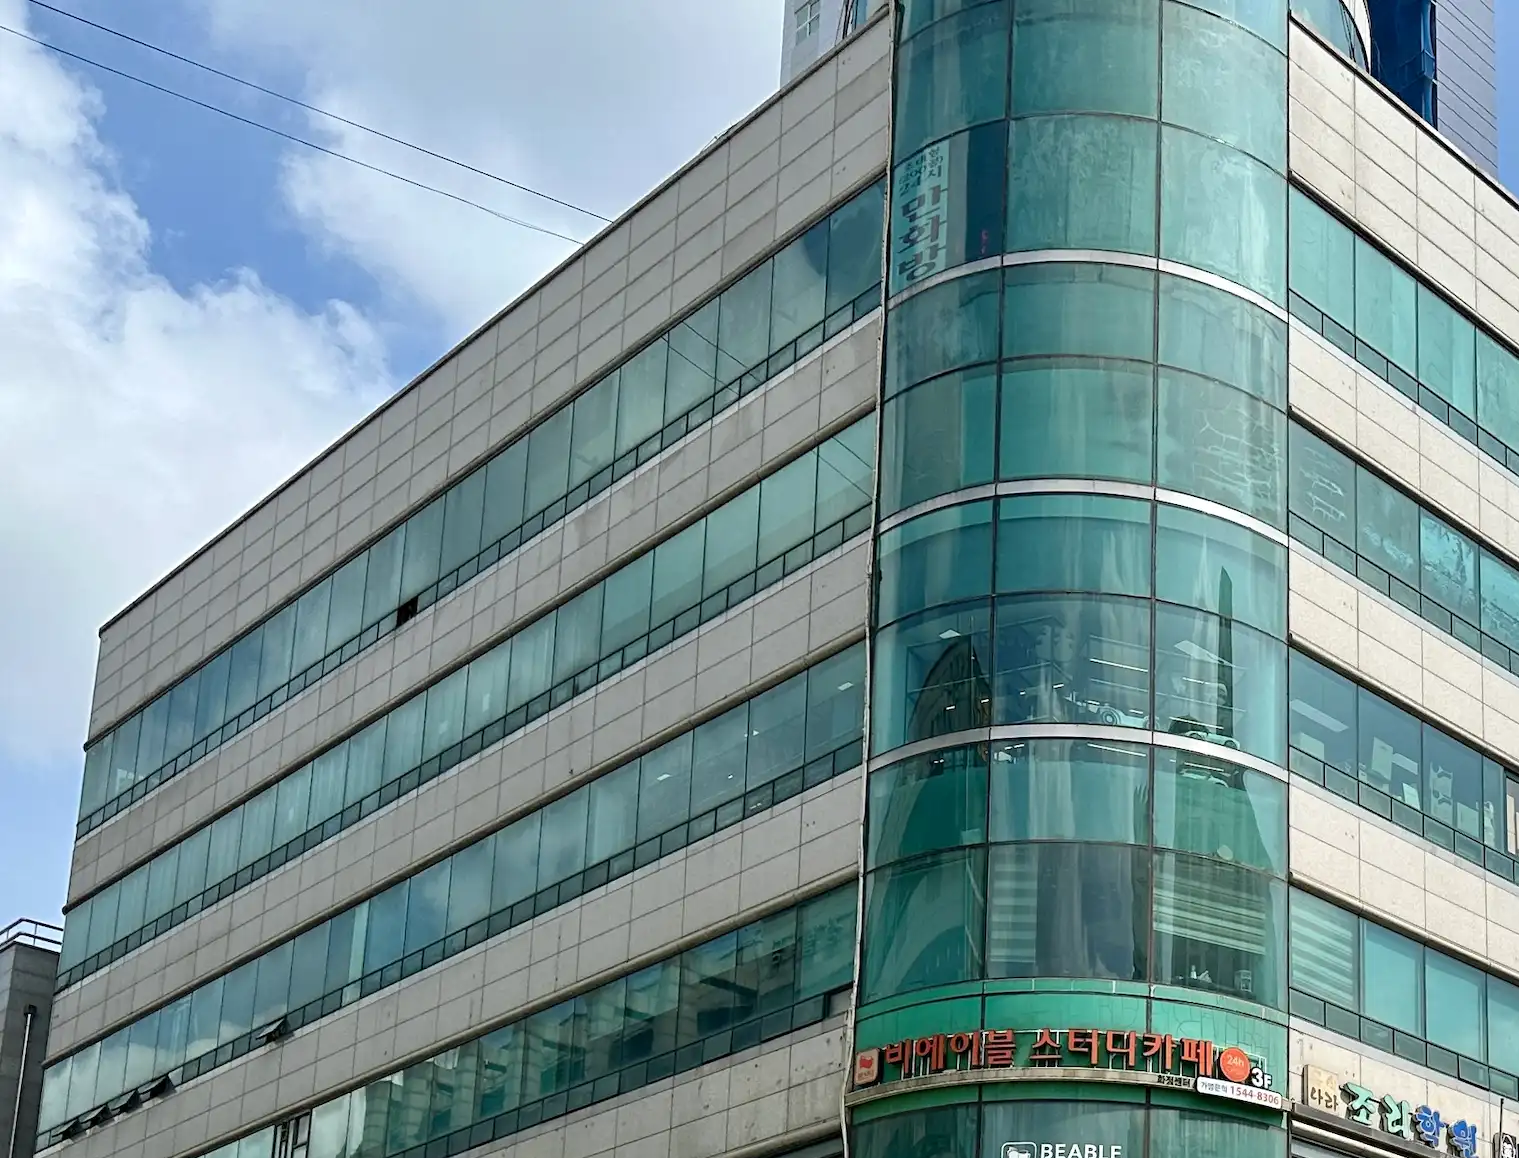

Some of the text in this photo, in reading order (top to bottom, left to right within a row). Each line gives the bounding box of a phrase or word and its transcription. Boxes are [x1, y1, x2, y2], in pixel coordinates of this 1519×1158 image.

[884, 1028, 1213, 1077] 비에이블 스터디카페
[1251, 1067, 1273, 1088] 3F
[1230, 1085, 1280, 1105] 1544-8306
